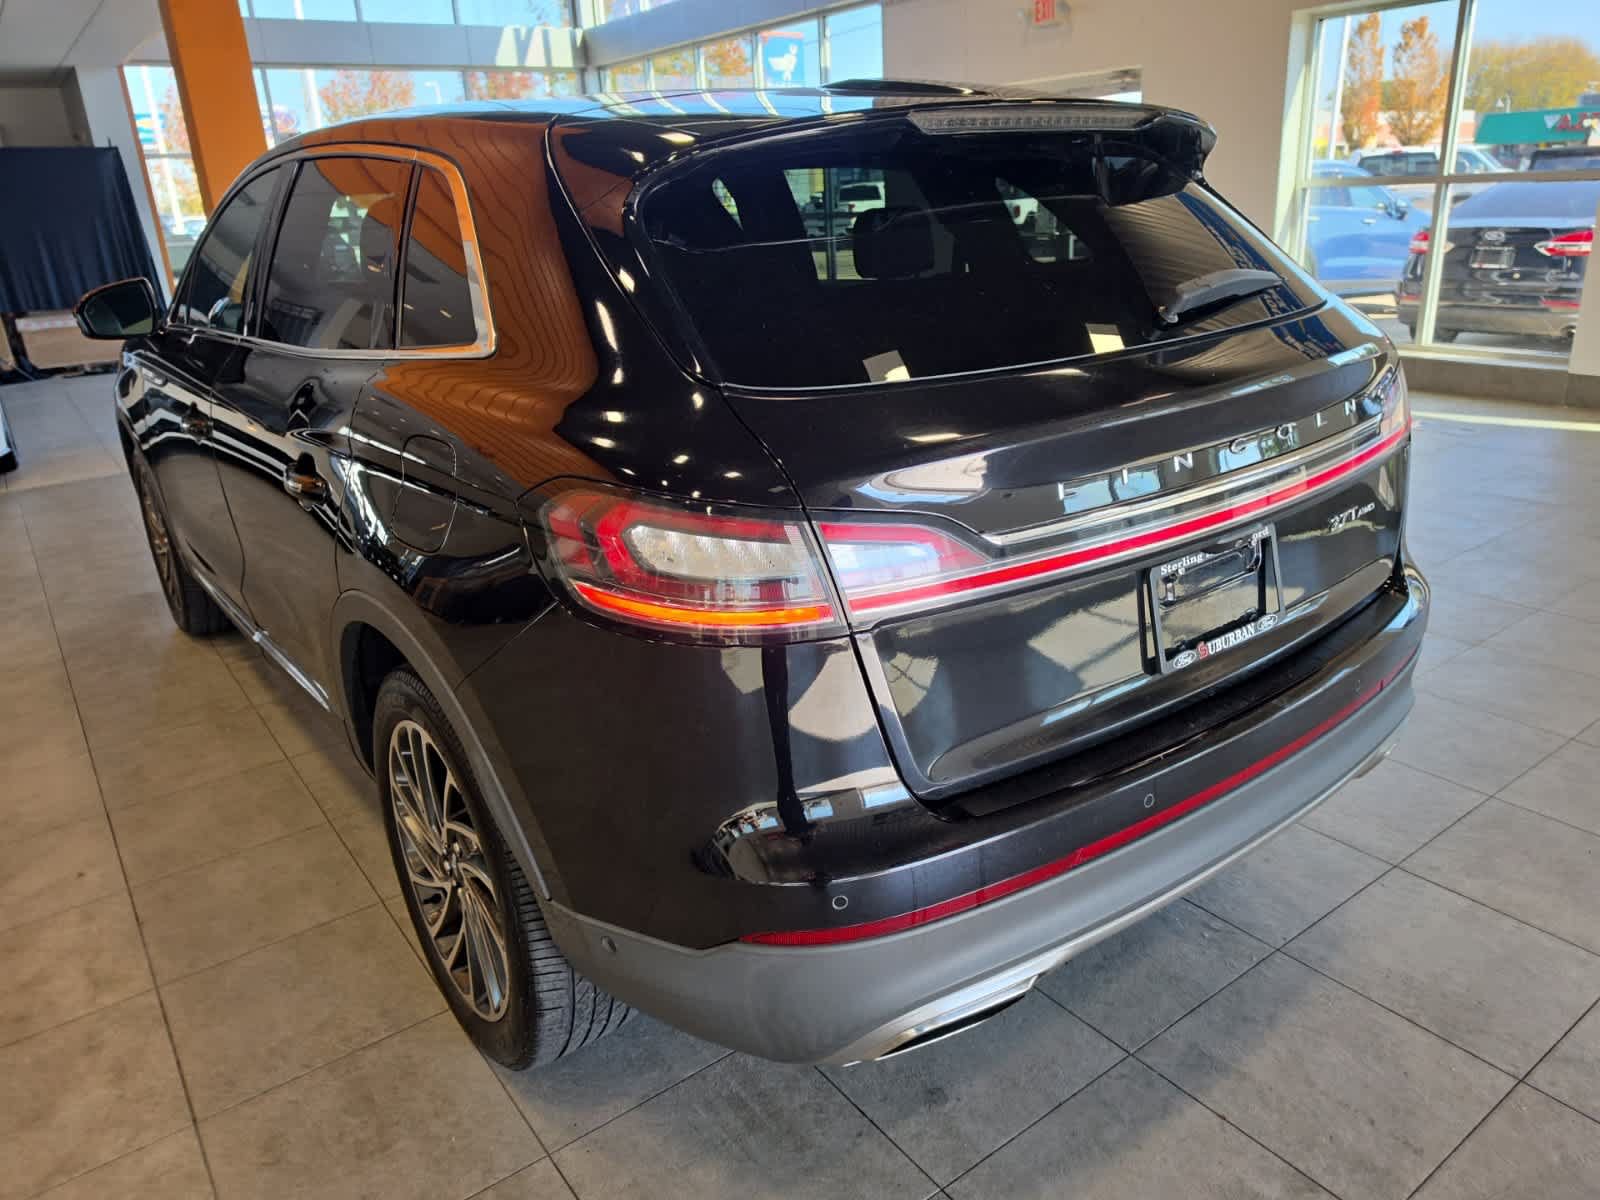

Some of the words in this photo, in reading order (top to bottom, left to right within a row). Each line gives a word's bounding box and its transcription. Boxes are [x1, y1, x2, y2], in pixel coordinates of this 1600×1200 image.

[1034, 0, 1056, 24] EXIT
[1057, 398, 1357, 499] LINCOLN
[1160, 552, 1203, 575] Sterling
[1198, 622, 1256, 660] SUBURBAN
